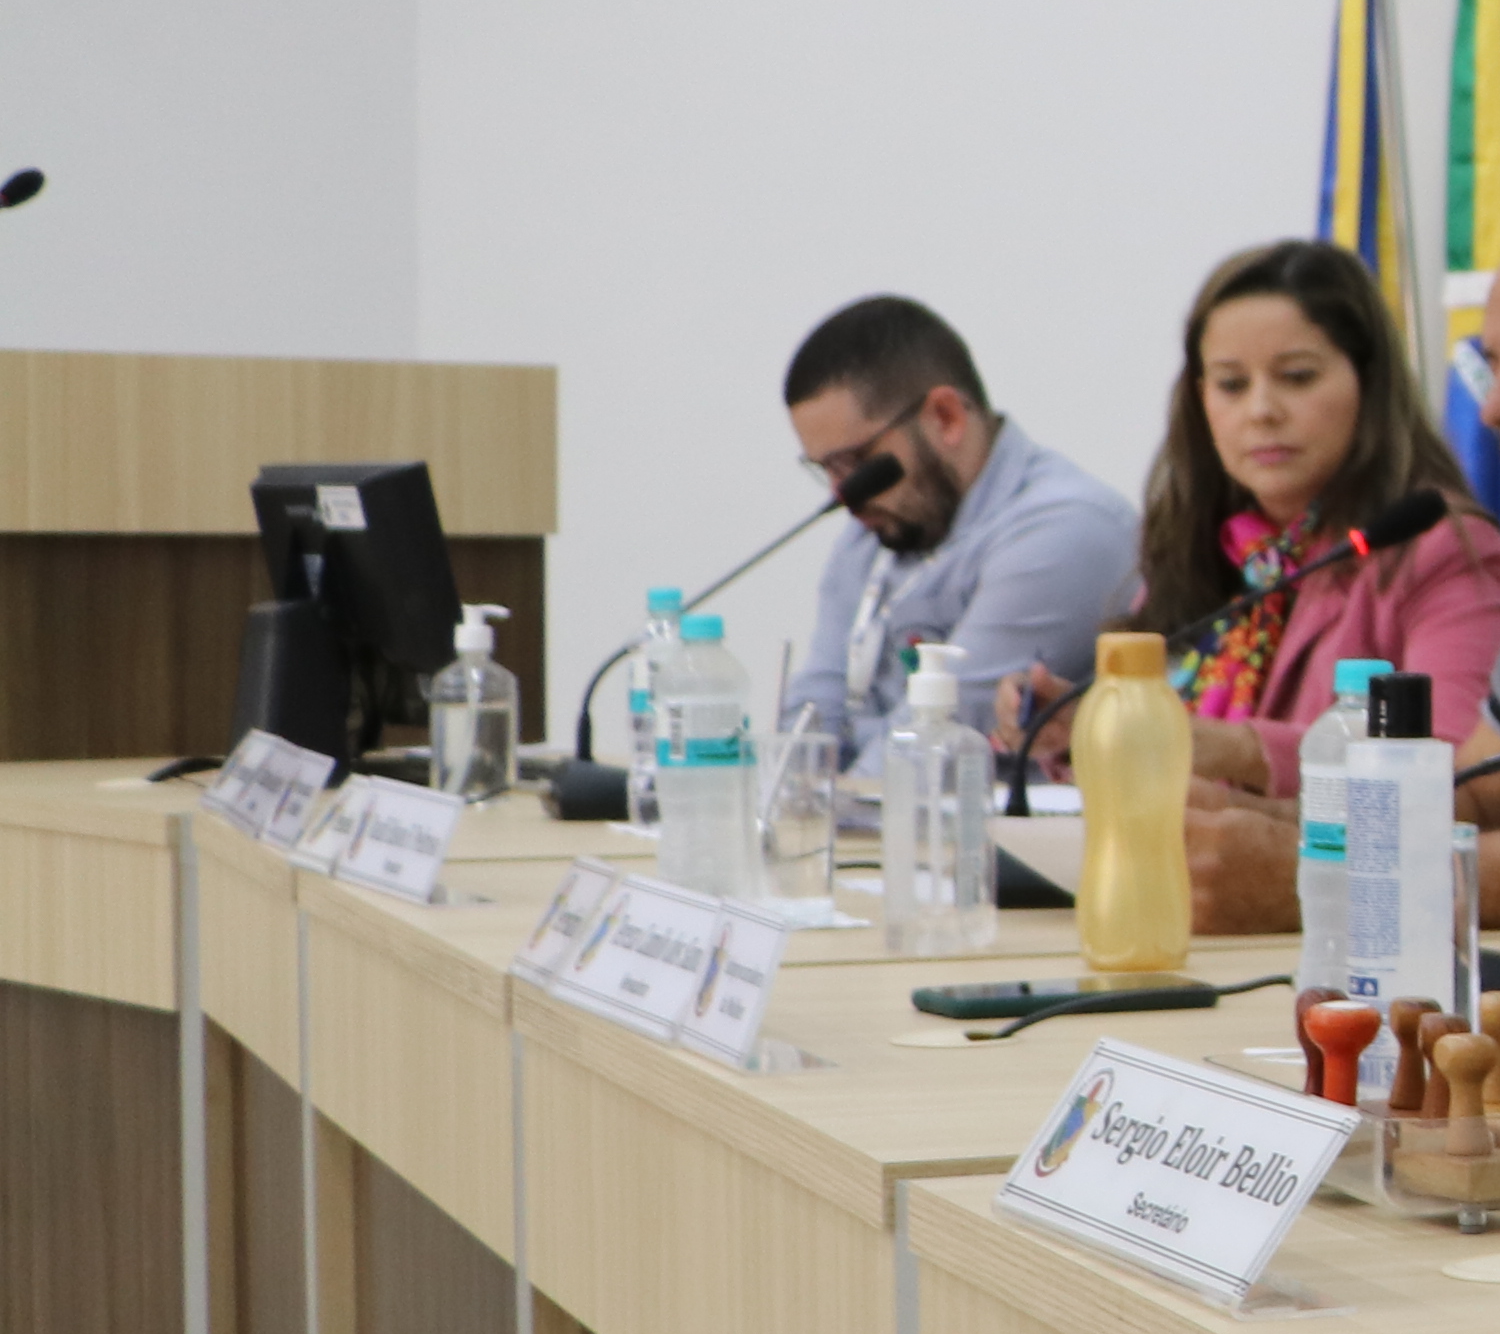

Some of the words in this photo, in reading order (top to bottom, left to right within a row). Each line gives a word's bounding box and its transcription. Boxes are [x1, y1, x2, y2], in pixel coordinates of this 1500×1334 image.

[1091, 1101, 1169, 1165] Sergio
[1161, 1125, 1230, 1181] Eloir
[1218, 1145, 1299, 1207] Bellio
